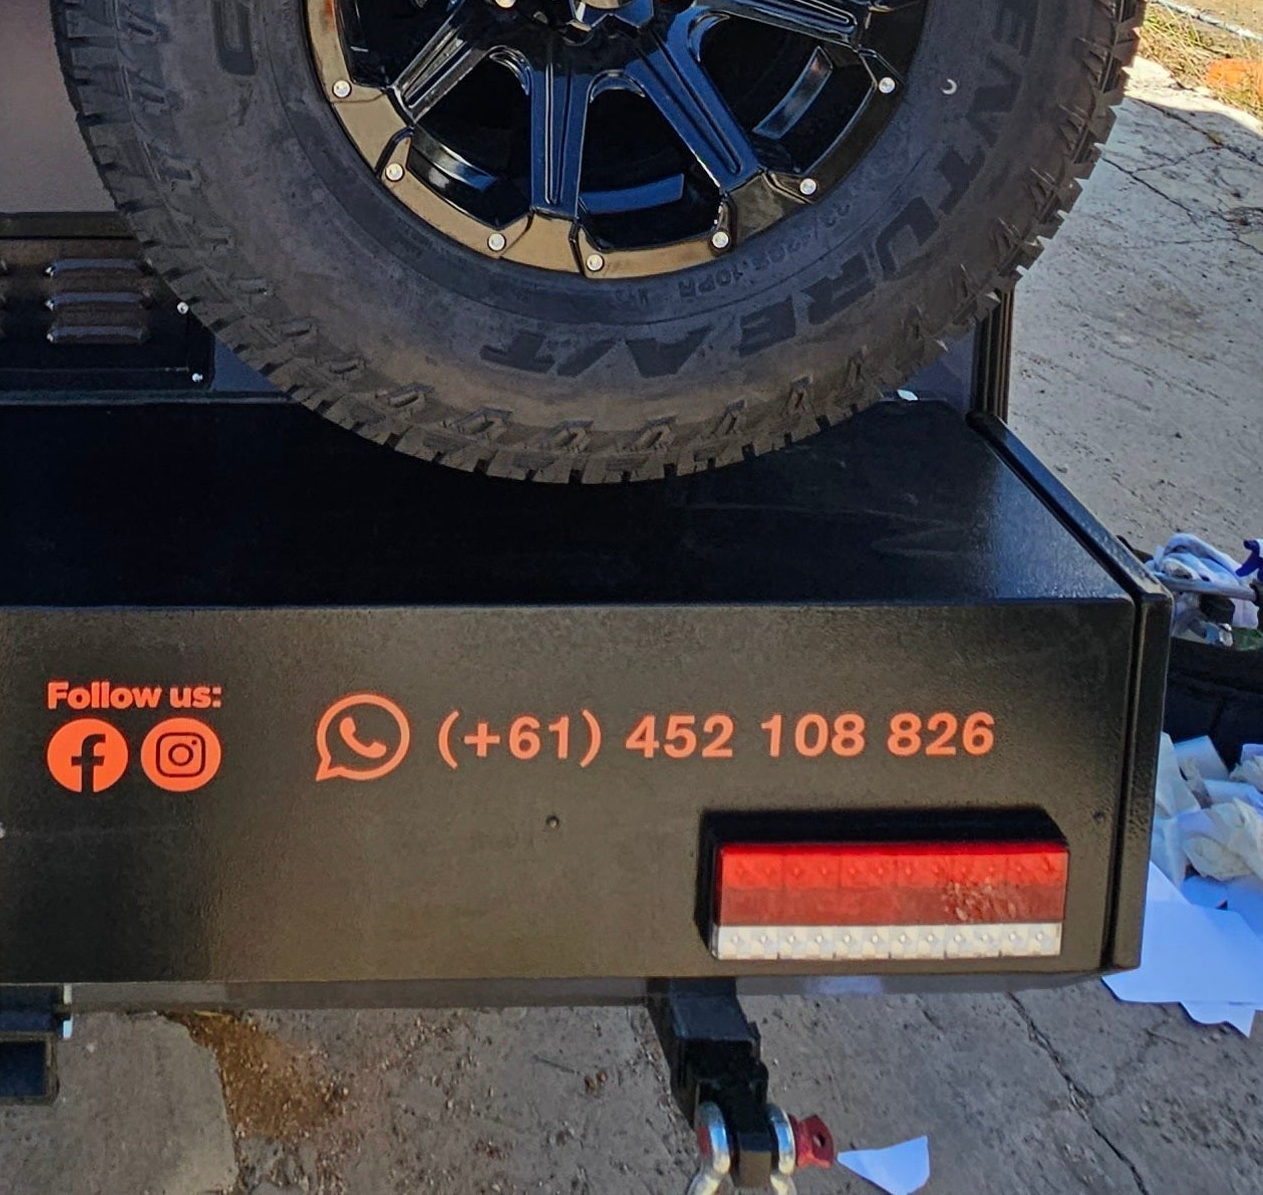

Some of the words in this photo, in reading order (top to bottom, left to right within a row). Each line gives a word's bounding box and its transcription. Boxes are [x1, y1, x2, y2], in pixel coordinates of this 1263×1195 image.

[47, 682, 163, 710] Follow
[169, 686, 222, 709] us:
[438, 709, 602, 769] (+61)
[625, 713, 734, 759] 452
[760, 712, 866, 758] 108
[886, 711, 995, 757] 826
